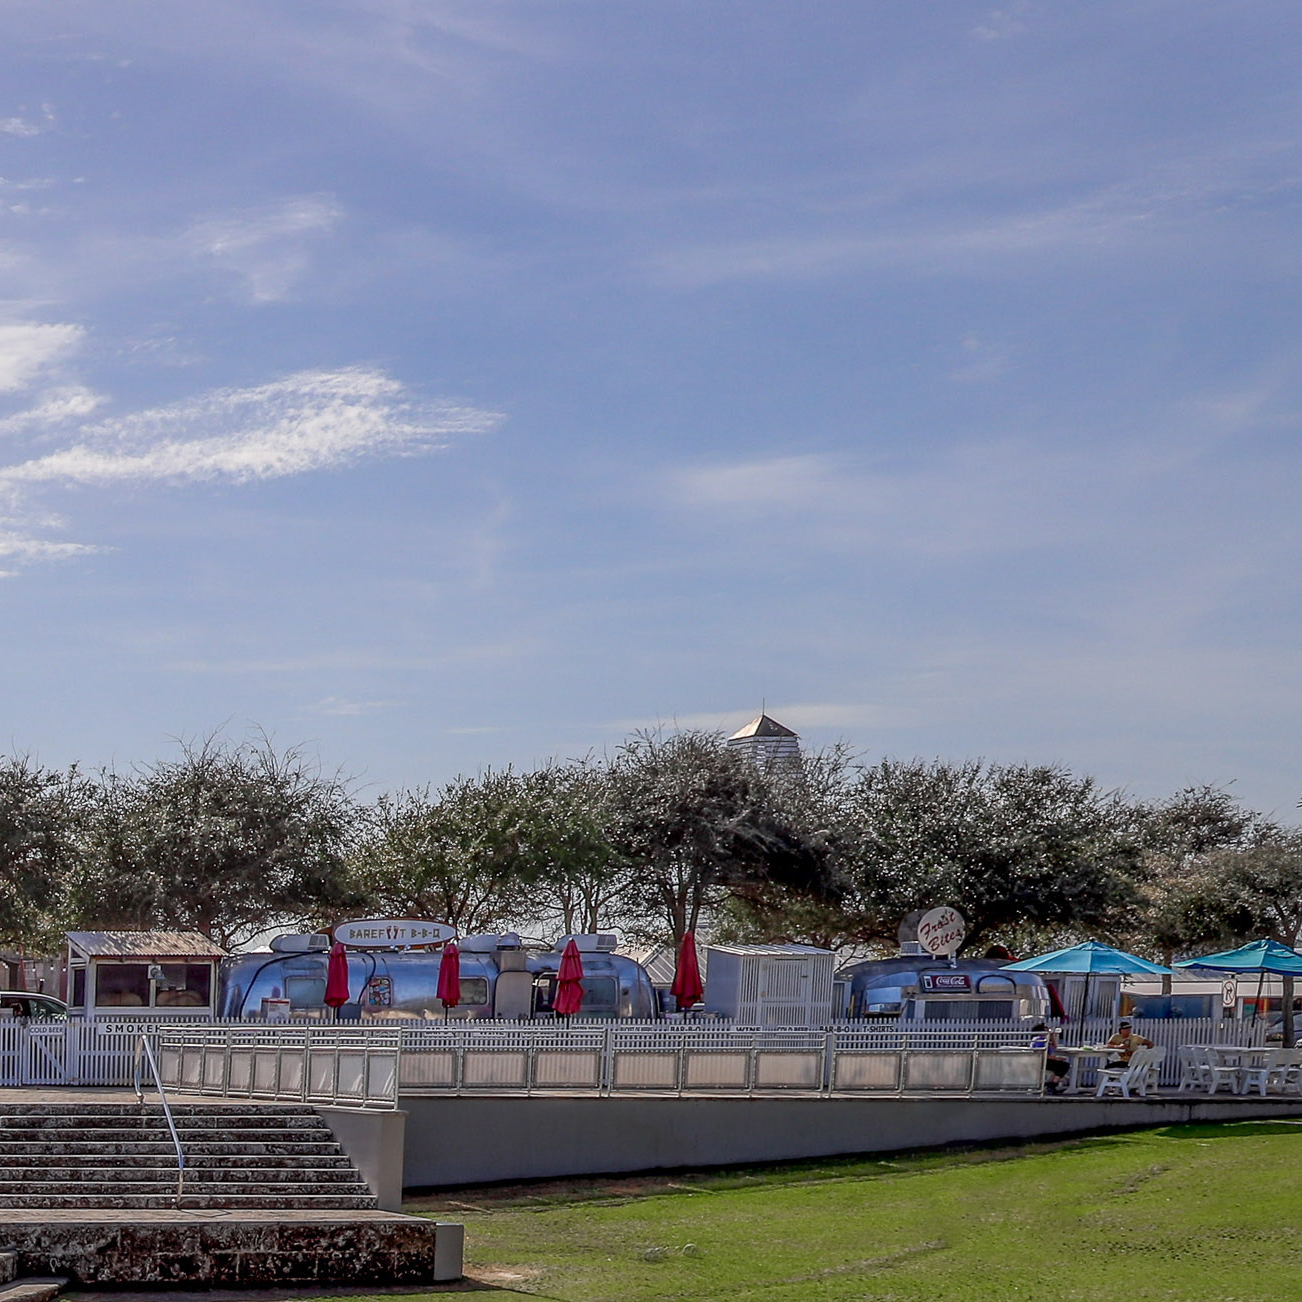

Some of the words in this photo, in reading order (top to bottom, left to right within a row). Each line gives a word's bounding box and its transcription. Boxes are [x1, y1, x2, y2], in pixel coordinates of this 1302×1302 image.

[920, 911, 955, 940] Frost
[29, 1026, 47, 1034] COLD
[48, 1026, 64, 1034] BEER
